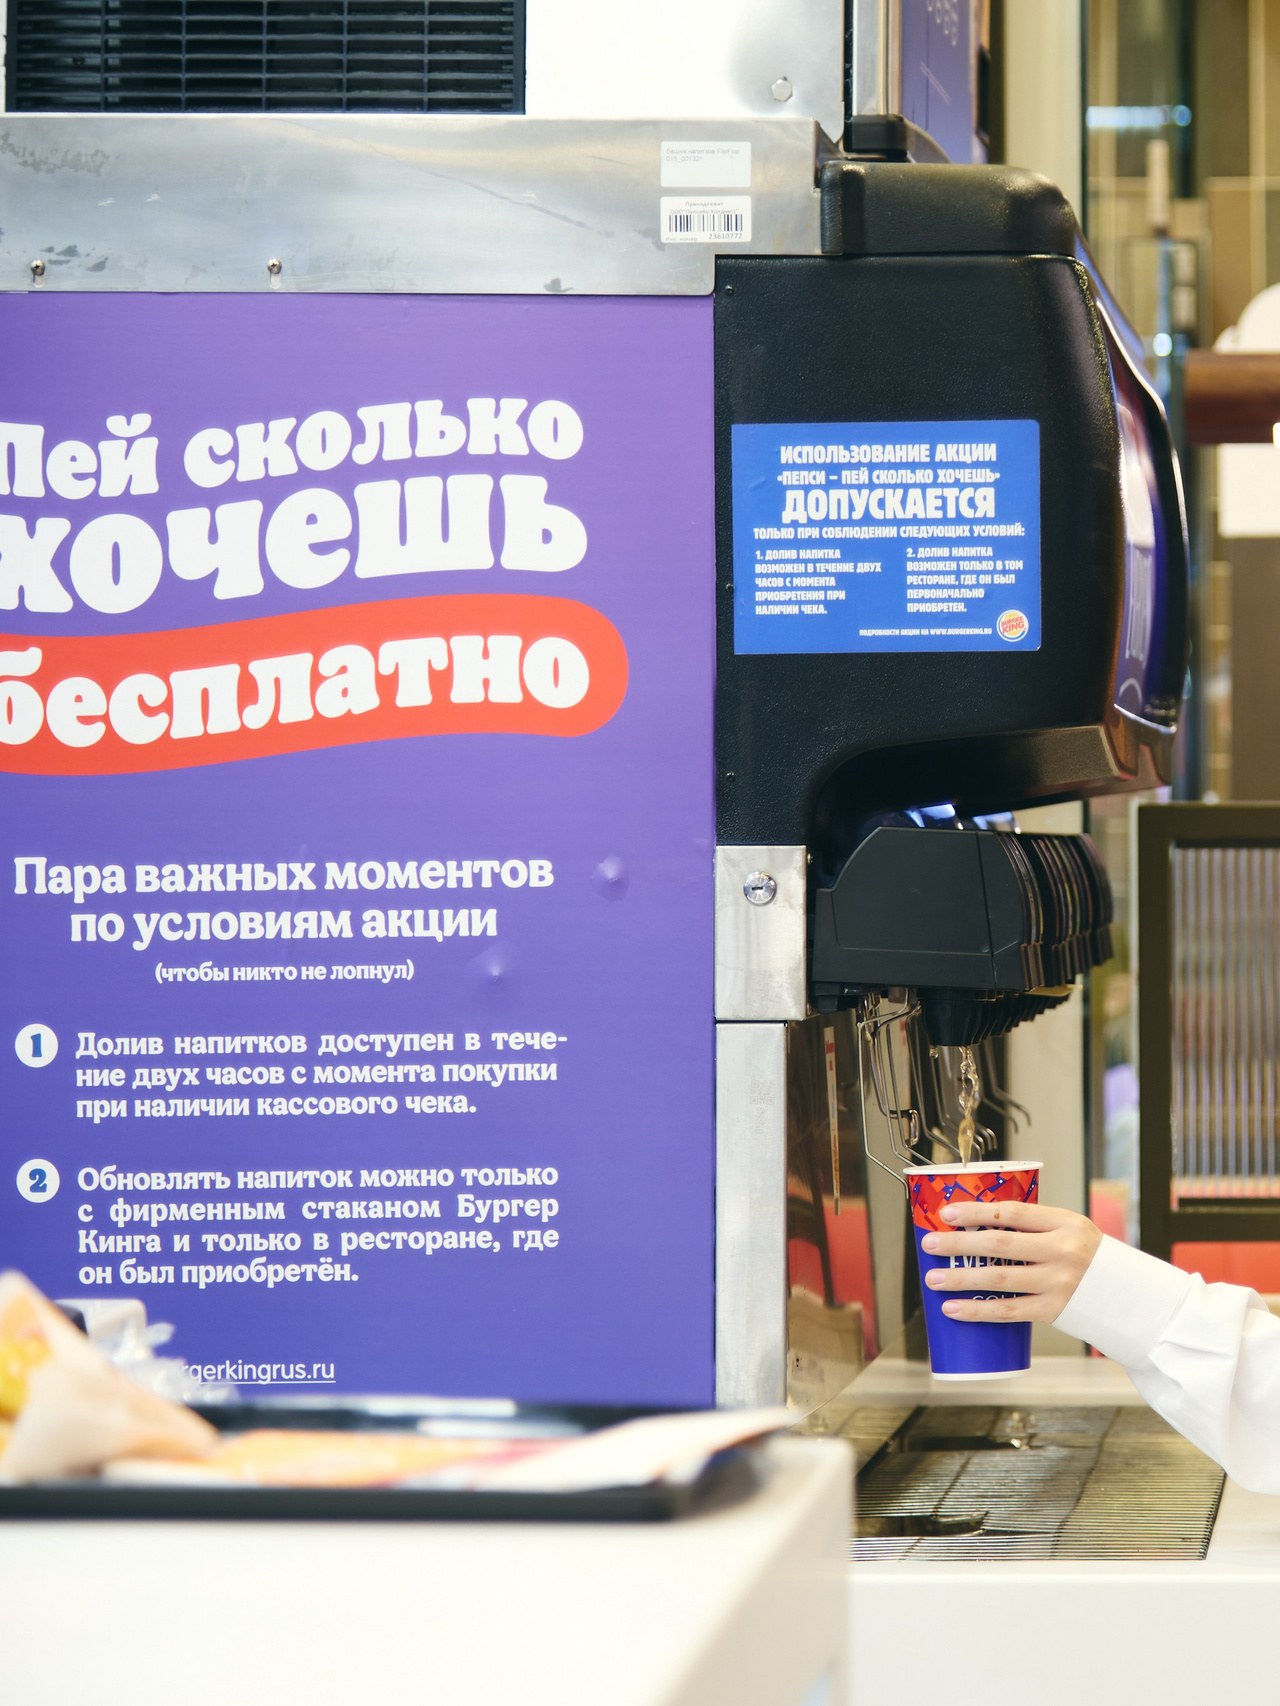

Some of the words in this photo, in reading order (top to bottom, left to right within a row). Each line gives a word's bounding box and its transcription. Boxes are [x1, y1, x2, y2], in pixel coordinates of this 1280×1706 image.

[0, 413, 159, 500] Пей
[184, 397, 584, 489] сколько
[781, 444, 930, 464] ИСПОЛЬЗОВАНИЕ
[935, 443, 997, 464] АКЦИИ
[777, 470, 826, 485] «ПЕПСИ
[841, 467, 869, 485] ПЕЙ
[872, 469, 934, 484] СКОЛЬКО
[937, 468, 1000, 483] ХОЧЕШЬ»
[782, 487, 995, 524] ДОПУСКАЕТСЯ
[753, 527, 795, 539] ТОЛЬКО
[797, 527, 820, 539] ПРИ
[822, 526, 897, 539] СОБЛЮДЕНИИ
[899, 525, 971, 538] СЛЕДУЮЩИХ
[972, 523, 1025, 537] УСЛОВИЙ:
[0, 473, 587, 614] хочешь
[906, 547, 916, 558] 2.
[917, 547, 950, 558] ДОЛИВ
[952, 547, 993, 557] НАПИТКА
[755, 550, 764, 560] 1.
[765, 549, 798, 561] ДОЛИВ
[799, 549, 841, 559] НАПИТКА
[906, 561, 957, 571] ВОЗМОЖЕН
[959, 560, 994, 571] ТОЛЬКО
[996, 560, 1003, 570] В
[1004, 560, 1023, 570] ТОМ
[755, 563, 805, 574] ВОЗМОЖЕН
[807, 563, 814, 573] В
[815, 562, 855, 573] ТЕЧЕНИЕ
[856, 562, 882, 573] ДВУХ
[755, 577, 784, 587] ЧАСОВ
[785, 577, 791, 587] С
[793, 577, 836, 587] МОМЕНТА
[907, 575, 959, 585] РЕСТОРАНЕ,
[960, 574, 977, 585] ГДЕ
[979, 574, 992, 584] ОН
[993, 574, 1015, 584] БЫЛ
[755, 590, 825, 601] ПРИОБРЕТЕНИЯ
[827, 590, 846, 600] ПРИ
[907, 588, 985, 599] ПЕРВОНАЧАЛЬНО
[755, 605, 799, 615] НАЛИЧИИ
[801, 604, 827, 614] ЧЕКА.
[907, 602, 967, 613] ПРИОБРЕТЕН.
[1000, 616, 1023, 627] BURGER
[1002, 621, 1025, 635] KING
[859, 629, 900, 637] ПОДРОБНОСТИ
[0, 635, 590, 747] бесплатно
[14, 857, 127, 904] Пара
[135, 862, 316, 893] важных
[324, 859, 554, 890] моментов
[71, 913, 125, 942] по
[133, 910, 353, 951] условиям
[362, 909, 497, 942] акции
[155, 961, 229, 984] (чтобы
[233, 966, 298, 981] никто
[301, 966, 327, 980] не
[330, 959, 414, 984] лопнул)
[75, 1032, 164, 1059] Долив
[174, 1035, 307, 1054] напитков
[318, 1033, 454, 1058] доступен
[465, 1033, 481, 1050] в
[491, 1032, 567, 1050] тече-
[76, 1068, 126, 1087] ние
[132, 1068, 200, 1092] двух
[206, 1066, 285, 1085] часов
[291, 1066, 307, 1084] с
[313, 1064, 436, 1083] момента
[442, 1063, 557, 1087] покупки
[76, 1100, 127, 1124] при
[134, 1098, 250, 1117] наличии
[257, 1096, 398, 1115] кассового
[405, 1095, 477, 1114] чека.
[78, 1165, 231, 1191] Обновлять
[237, 1170, 353, 1189] напиток
[359, 1168, 454, 1187] можно
[461, 1167, 558, 1186] только
[78, 1204, 93, 1222] с
[110, 1197, 286, 1228] фирменным
[302, 1200, 441, 1219] стаканом
[457, 1194, 559, 1223] Бургер
[78, 1230, 162, 1253] Кинга
[173, 1234, 190, 1252] и
[201, 1233, 301, 1252] только
[313, 1233, 329, 1250] в
[341, 1230, 500, 1256] ресторане,
[513, 1229, 559, 1251] где
[79, 1266, 112, 1284] он
[119, 1258, 175, 1284] был
[182, 1256, 359, 1289] приобретён.
[182, 1359, 336, 1385] rgerkingrus.ru
